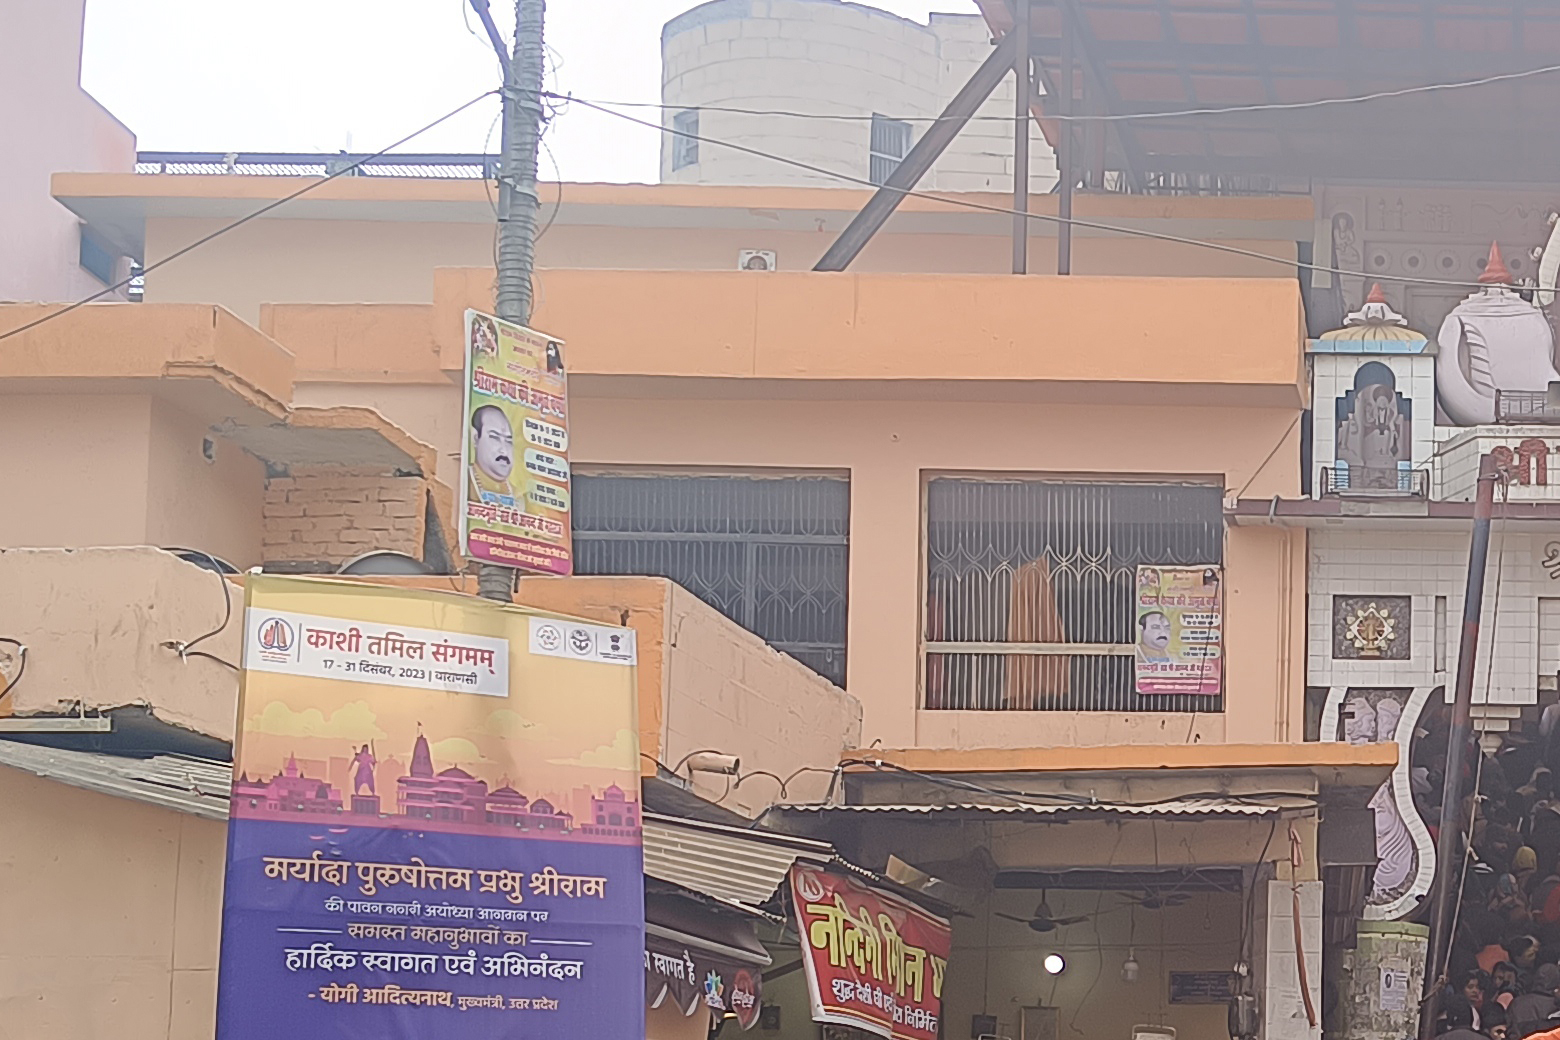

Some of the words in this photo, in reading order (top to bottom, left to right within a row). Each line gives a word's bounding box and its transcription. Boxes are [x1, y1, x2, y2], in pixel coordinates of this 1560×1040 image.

[1491, 438, 1549, 487] श्री
[306, 628, 362, 653] काशी
[367, 632, 426, 660] तमिल
[431, 638, 495, 675] संगमम्
[323, 660, 334, 670] 17
[345, 662, 356, 672] 31
[399, 667, 425, 680] 2023
[435, 671, 478, 685] वाराणसी
[263, 850, 352, 888] मर्यादा
[356, 857, 471, 896] पुरुषोत्तम
[478, 868, 524, 903] प्रभु
[529, 867, 607, 900] श्रीराम
[324, 899, 344, 913] की
[348, 901, 382, 915] पावन
[385, 900, 421, 917] नगरी
[424, 902, 474, 920] अयोध्या
[476, 908, 528, 922] आगमन
[531, 911, 549, 923] पर
[348, 923, 407, 940] समस्त
[410, 924, 500, 950] महानुभावों
[503, 930, 529, 947] का
[285, 943, 358, 972] हार्दिक
[362, 951, 438, 976] स्वागत
[442, 949, 477, 977] एवं
[482, 951, 584, 981] अभिनंदन
[652, 953, 685, 980] स्वागत
[683, 950, 696, 985] है
[319, 983, 359, 1003] योगी
[363, 985, 455, 1008] आदित्यनाथ,
[532, 997, 559, 1011] प्रदेश
[832, 978, 854, 1003] शुद्ध
